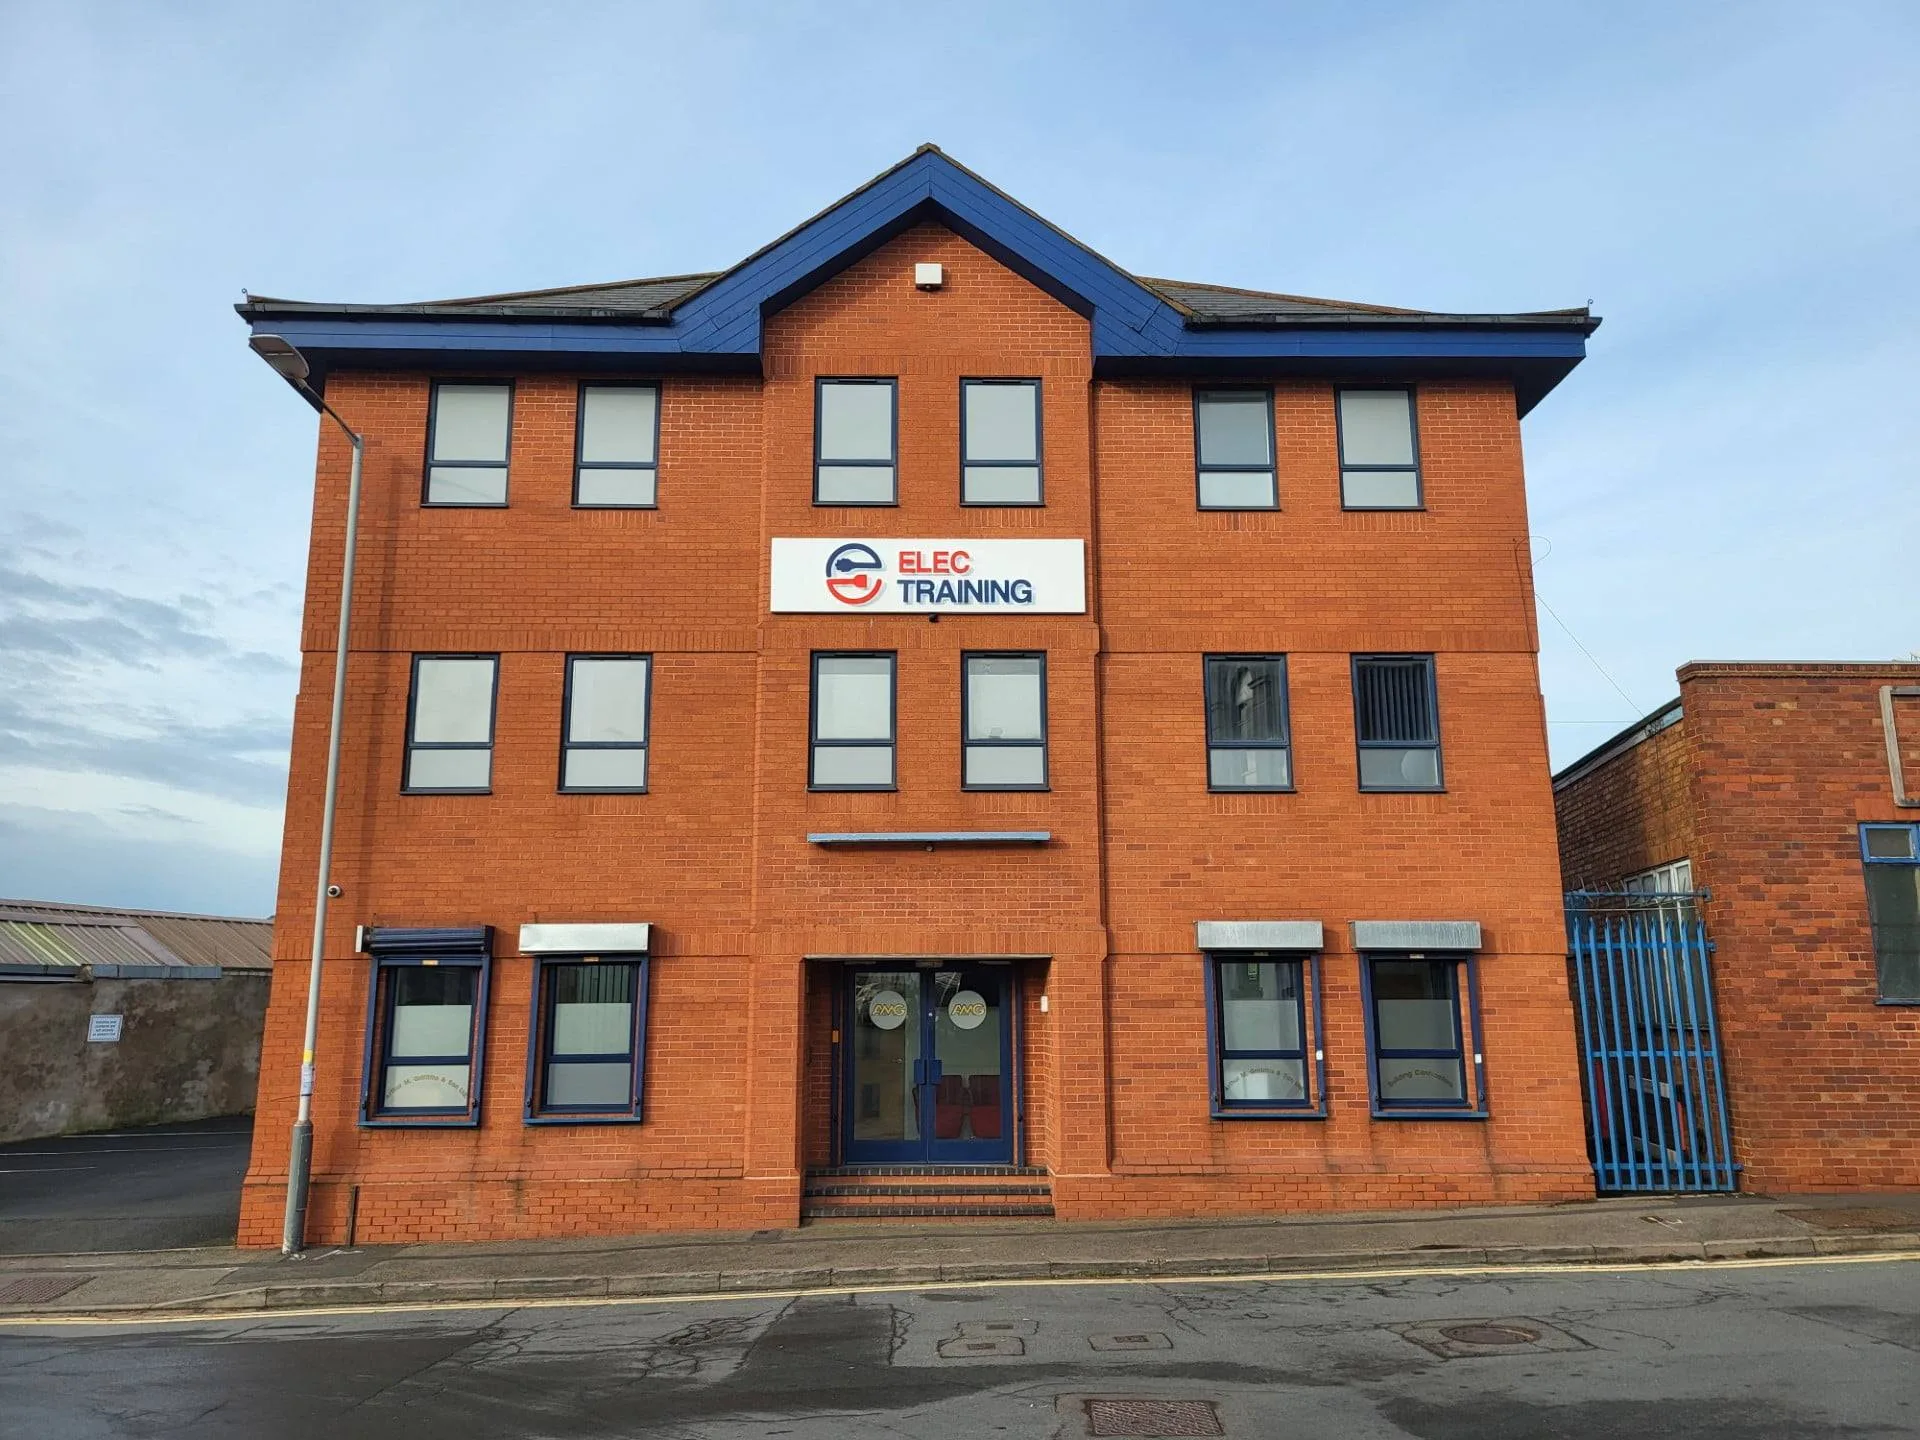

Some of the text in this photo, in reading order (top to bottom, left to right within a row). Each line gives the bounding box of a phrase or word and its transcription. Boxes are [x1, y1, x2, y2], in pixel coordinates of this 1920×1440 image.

[899, 550, 970, 574] ELEC
[897, 579, 1032, 604] TRAINING
[872, 1003, 906, 1017] AMG
[951, 1003, 986, 1017] AMG
